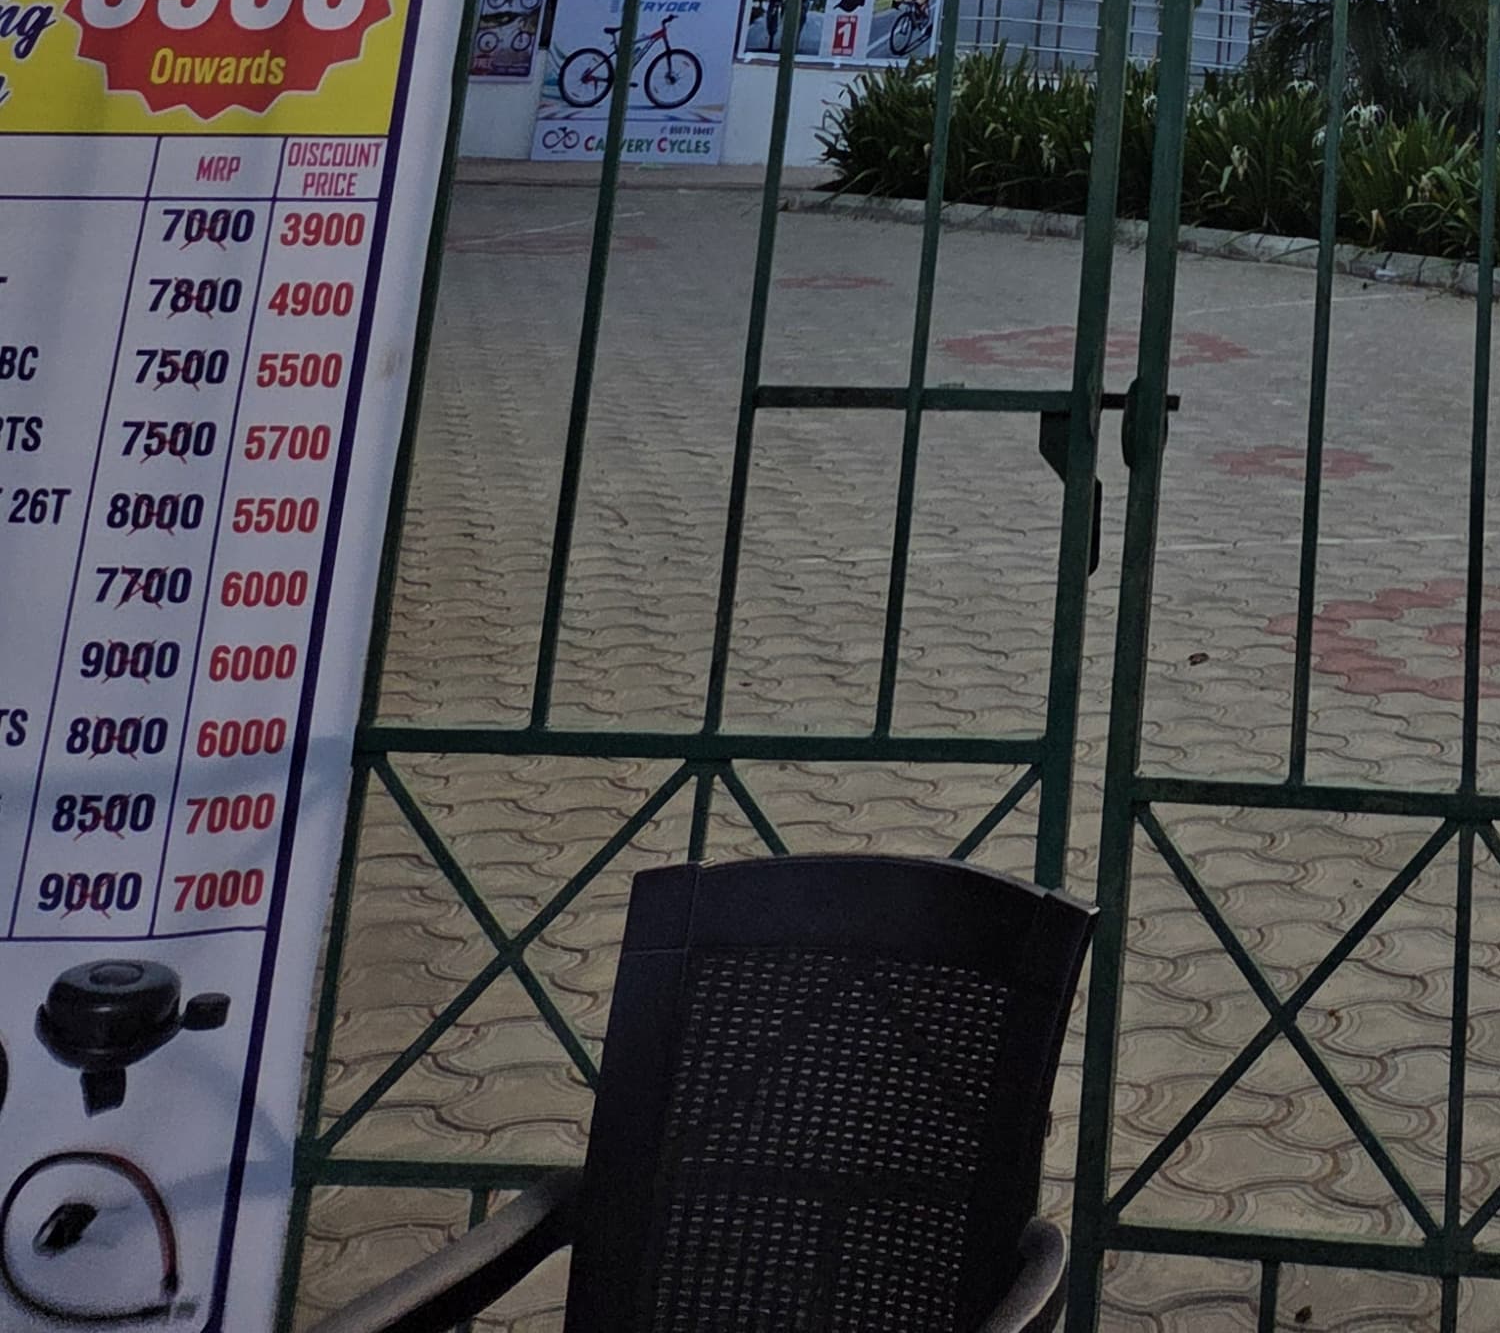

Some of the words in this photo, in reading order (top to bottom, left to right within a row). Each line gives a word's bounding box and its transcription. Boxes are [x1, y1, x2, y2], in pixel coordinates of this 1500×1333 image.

[151, 47, 286, 84] Onwards
[288, 142, 382, 167] DISCOUNT
[657, 137, 711, 154] CYCLES
[196, 157, 241, 181] MRP
[303, 173, 358, 196] PRICE
[162, 209, 255, 242] 7000
[280, 213, 365, 246] 3900
[149, 278, 242, 313] 7800
[269, 282, 354, 316] 4900
[135, 349, 229, 383] 7500
[256, 353, 342, 388] 5500
[121, 421, 216, 456] 7500
[244, 425, 331, 460] 5700
[8, 488, 72, 525] 26T
[107, 493, 204, 529] 8000
[232, 498, 319, 533] 5500
[95, 567, 191, 603] 7700
[221, 570, 308, 607] 6000
[80, 641, 180, 678] 9000
[209, 644, 297, 681] 6000
[66, 717, 168, 755] 8000
[196, 718, 287, 757] 6000
[52, 794, 155, 832] 8500
[186, 793, 275, 834] 7000
[38, 872, 142, 911] 9000
[174, 868, 264, 912] 7000
